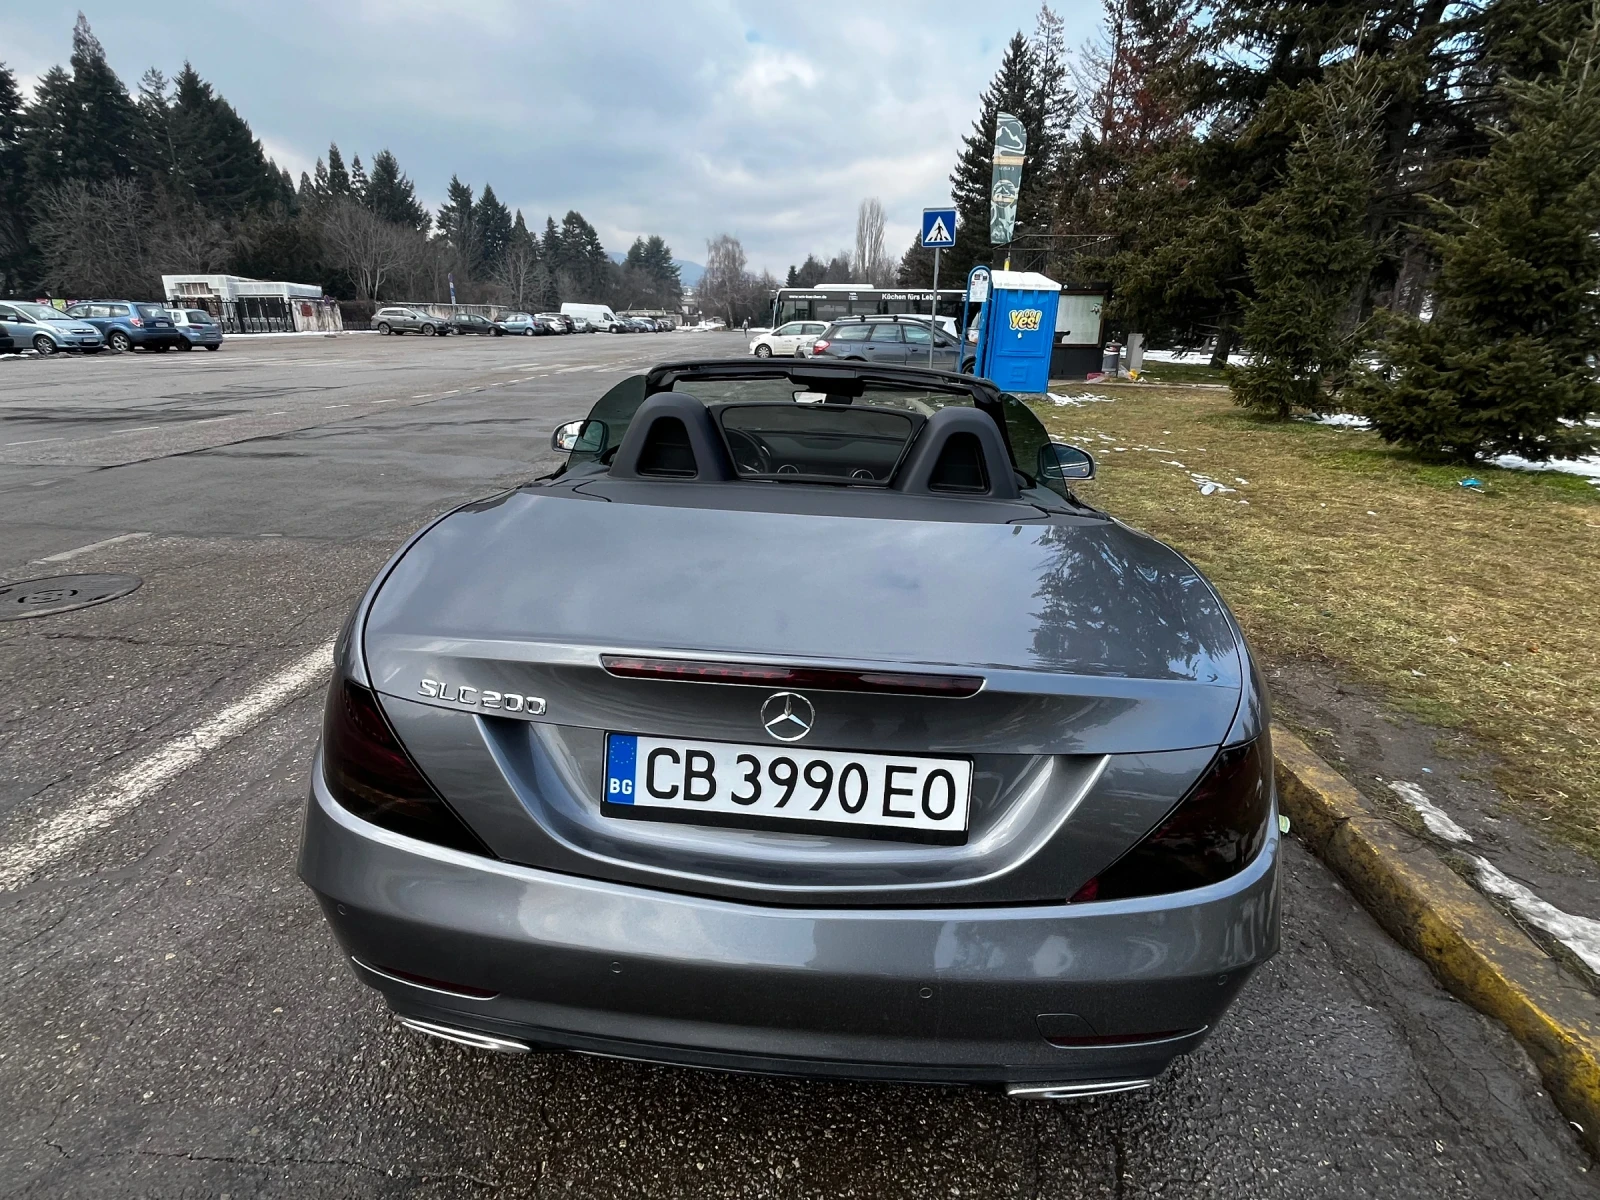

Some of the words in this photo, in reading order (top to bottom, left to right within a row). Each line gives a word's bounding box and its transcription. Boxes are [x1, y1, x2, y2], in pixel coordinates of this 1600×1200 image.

[1010, 310, 1041, 329] Yes!
[609, 777, 633, 795] BG
[645, 747, 717, 802] CB
[731, 753, 869, 814] 3990
